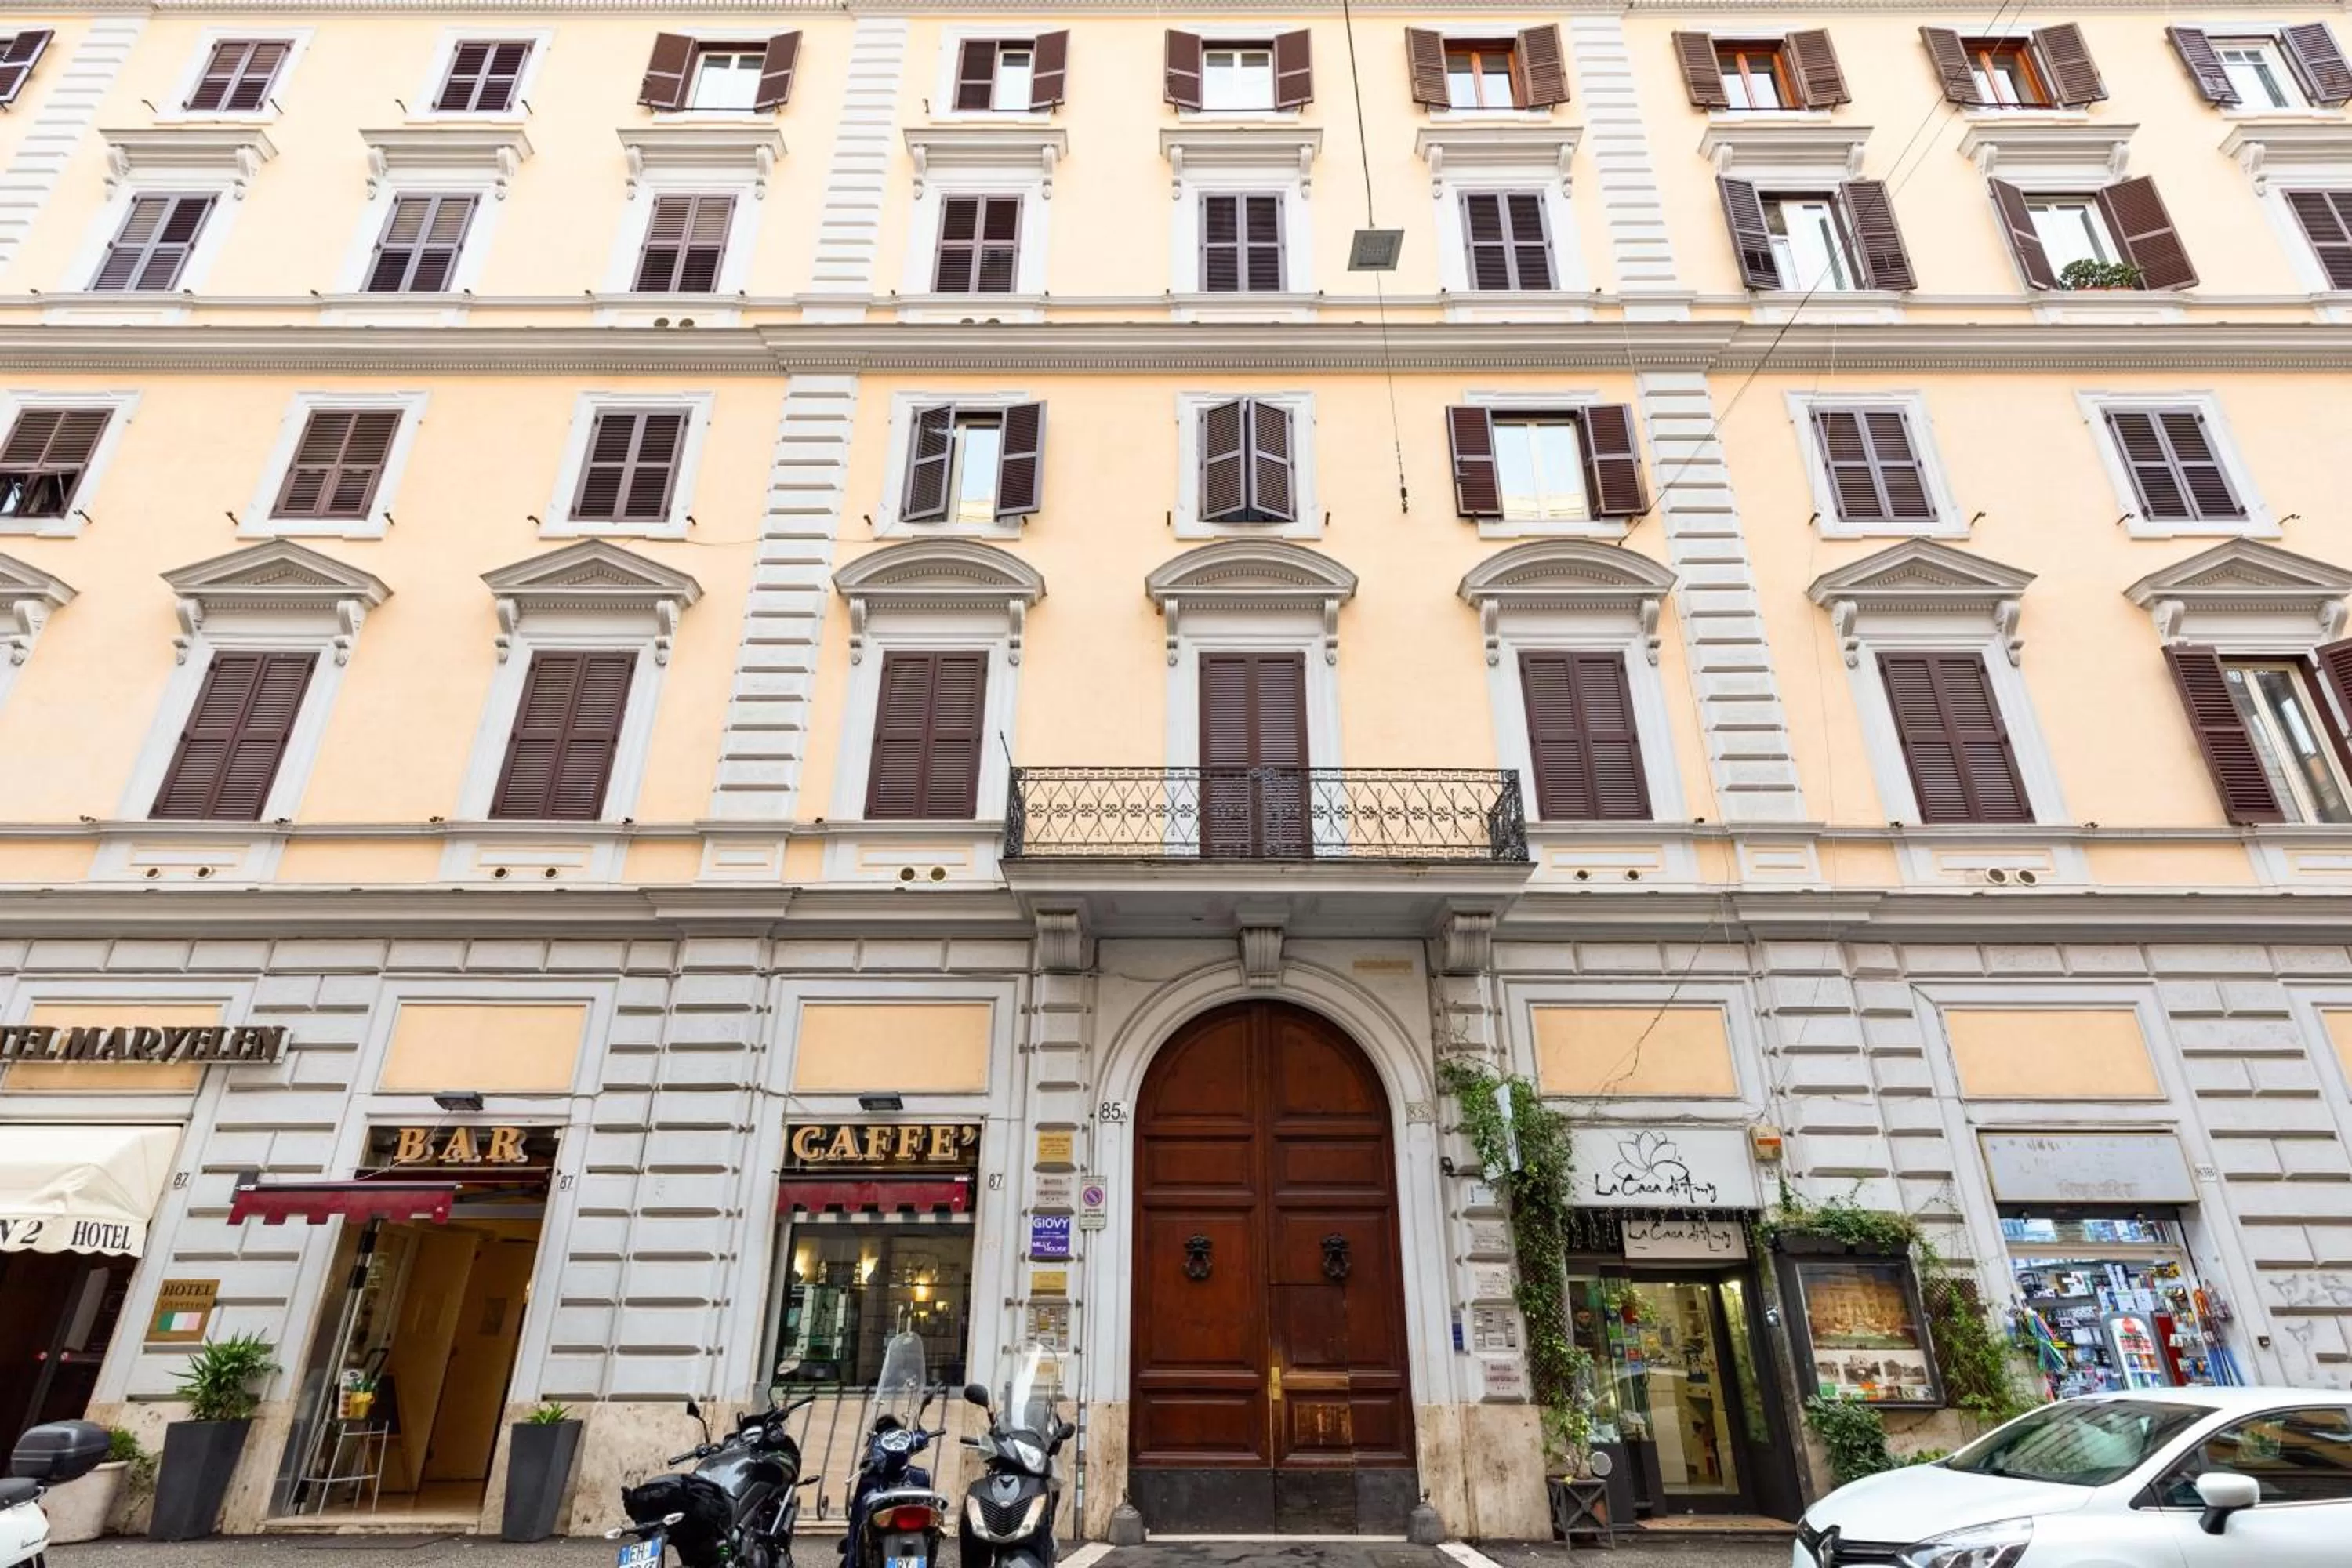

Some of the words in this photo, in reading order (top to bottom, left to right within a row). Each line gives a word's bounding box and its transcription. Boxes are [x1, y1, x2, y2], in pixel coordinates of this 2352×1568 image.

[393, 1127, 528, 1162] BAR
[559, 1176, 574, 1190] 87
[989, 1174, 1003, 1190] 87
[1033, 1218, 1069, 1229] GIOVY
[20, 1219, 44, 1245] 2
[71, 1220, 132, 1250] HOTEL
[162, 1283, 213, 1296] HOTEL
